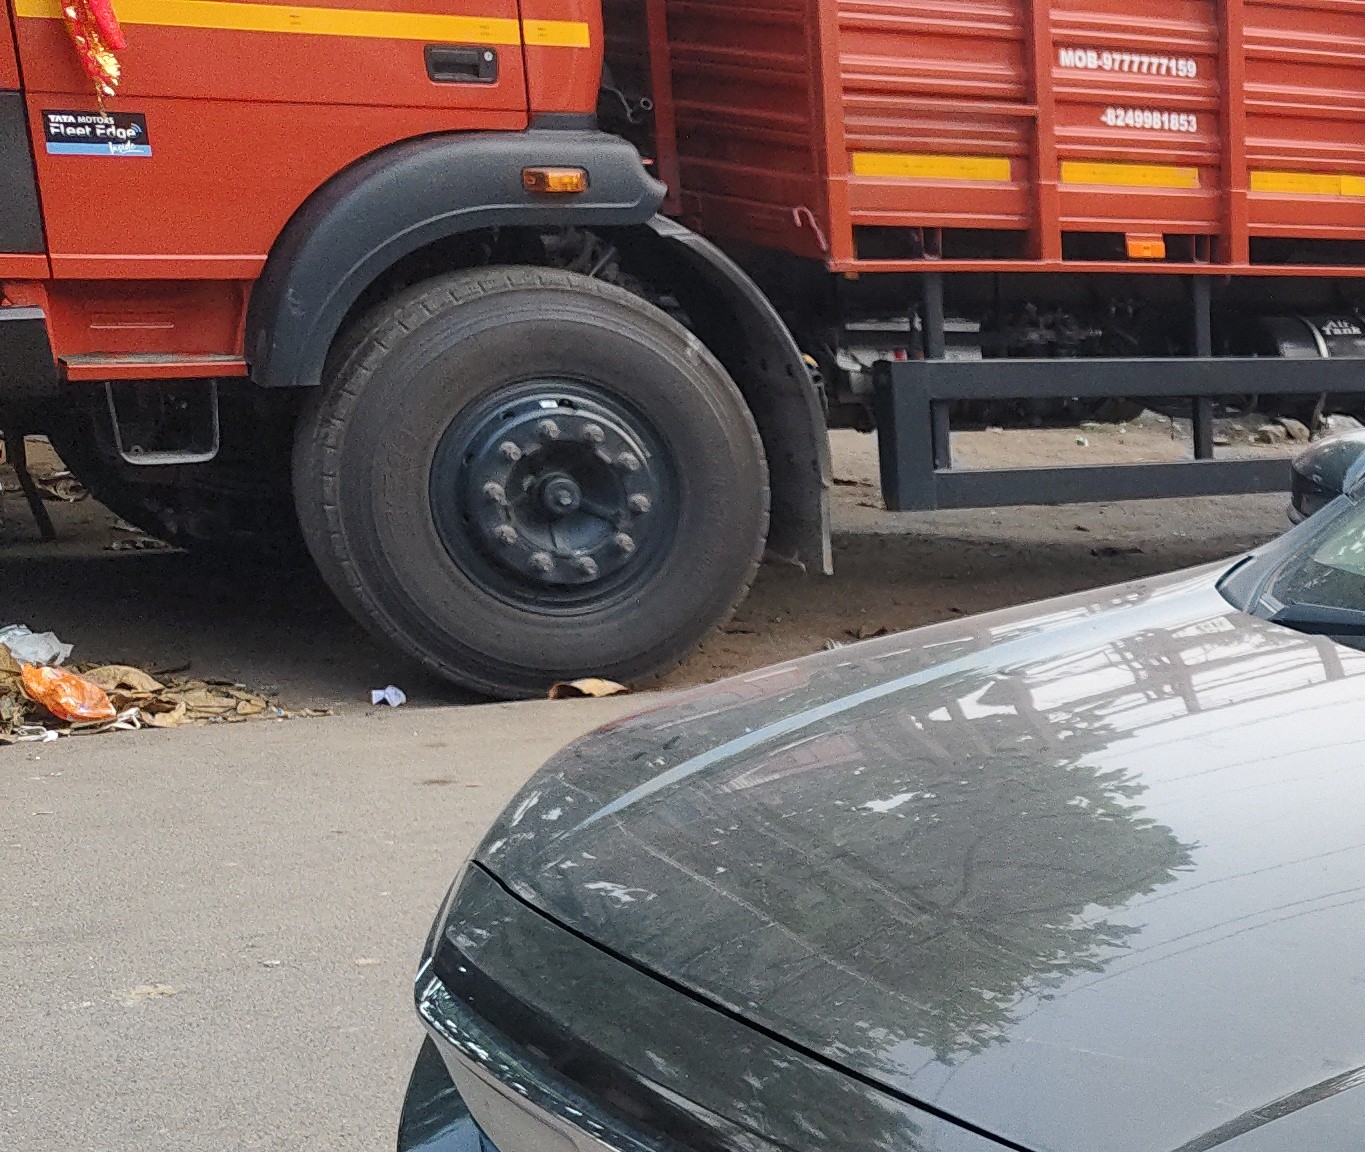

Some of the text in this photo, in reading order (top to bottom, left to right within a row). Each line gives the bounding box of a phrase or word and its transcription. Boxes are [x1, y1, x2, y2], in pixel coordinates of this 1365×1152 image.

[48, 114, 114, 125] TATA MOTORS
[49, 122, 136, 140] Fleet Edge
[1321, 326, 1362, 335] Tank
